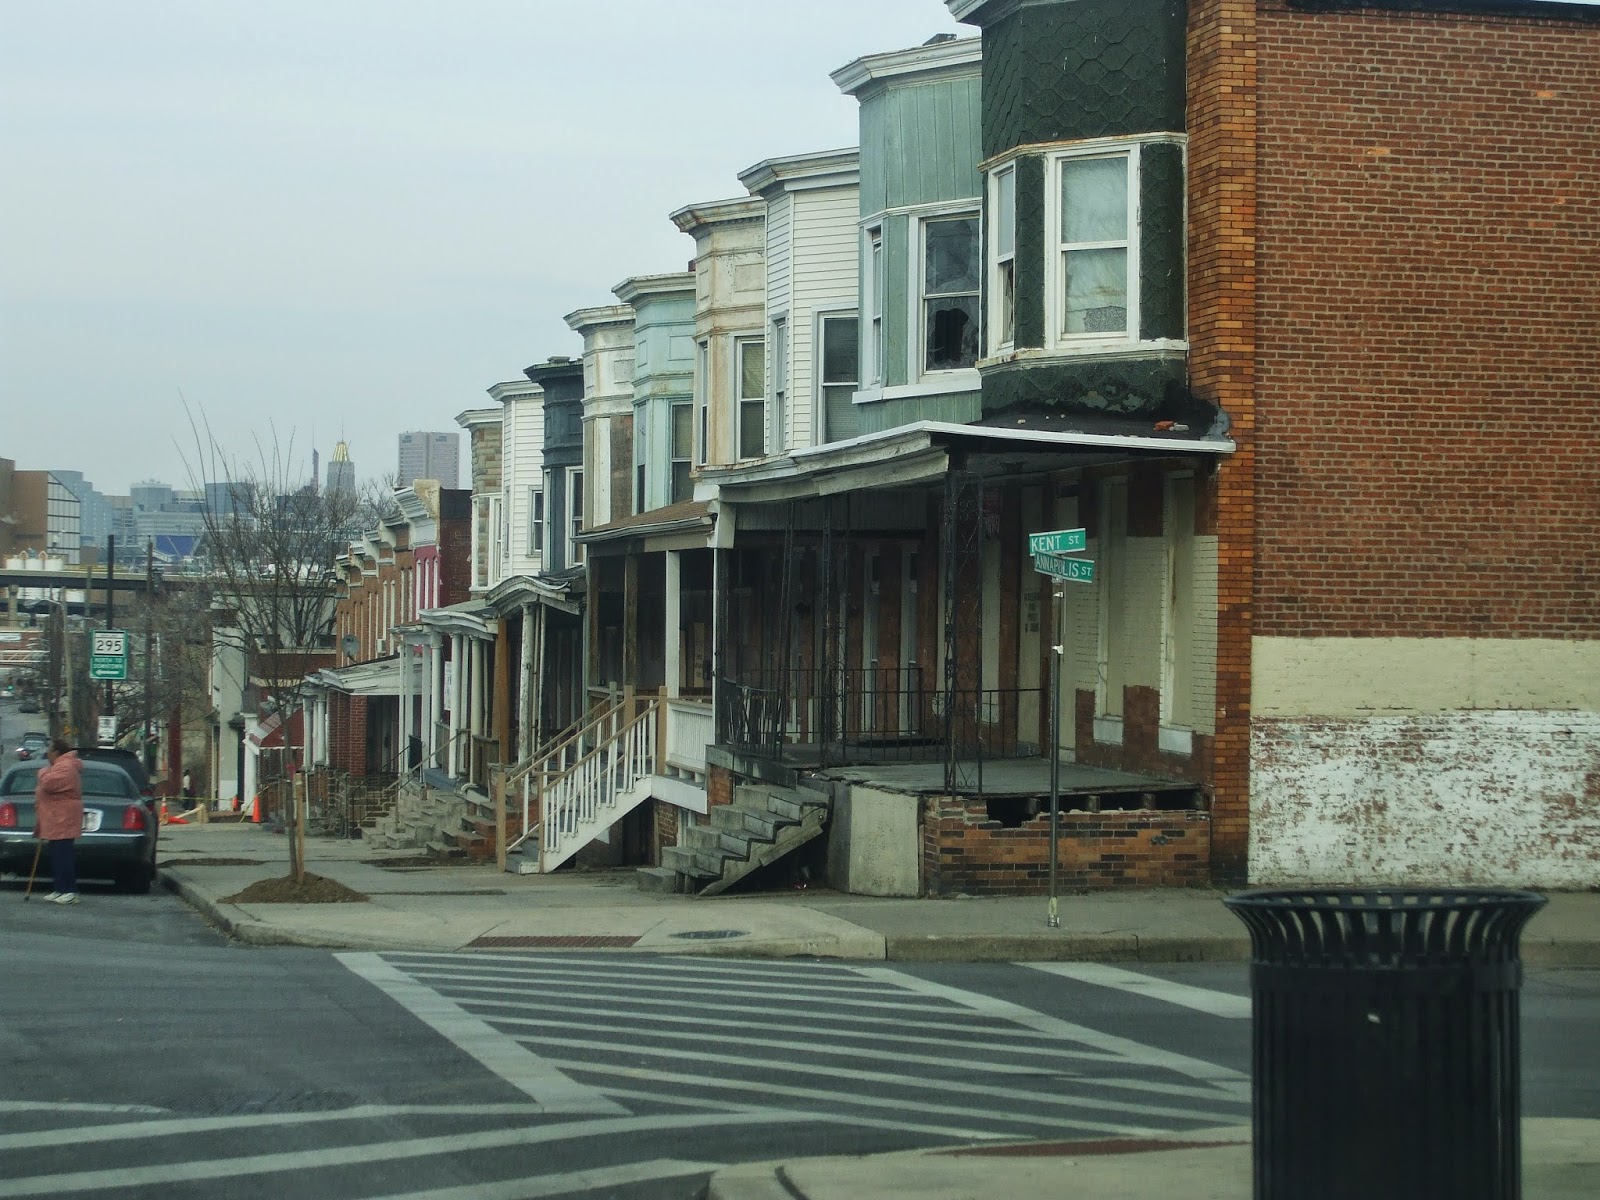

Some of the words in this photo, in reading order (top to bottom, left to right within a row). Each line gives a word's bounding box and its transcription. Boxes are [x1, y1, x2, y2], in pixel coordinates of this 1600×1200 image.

[1031, 536, 1061, 552] KENT
[1035, 555, 1079, 577] ANNAPOLIS
[96, 640, 122, 652] 295
